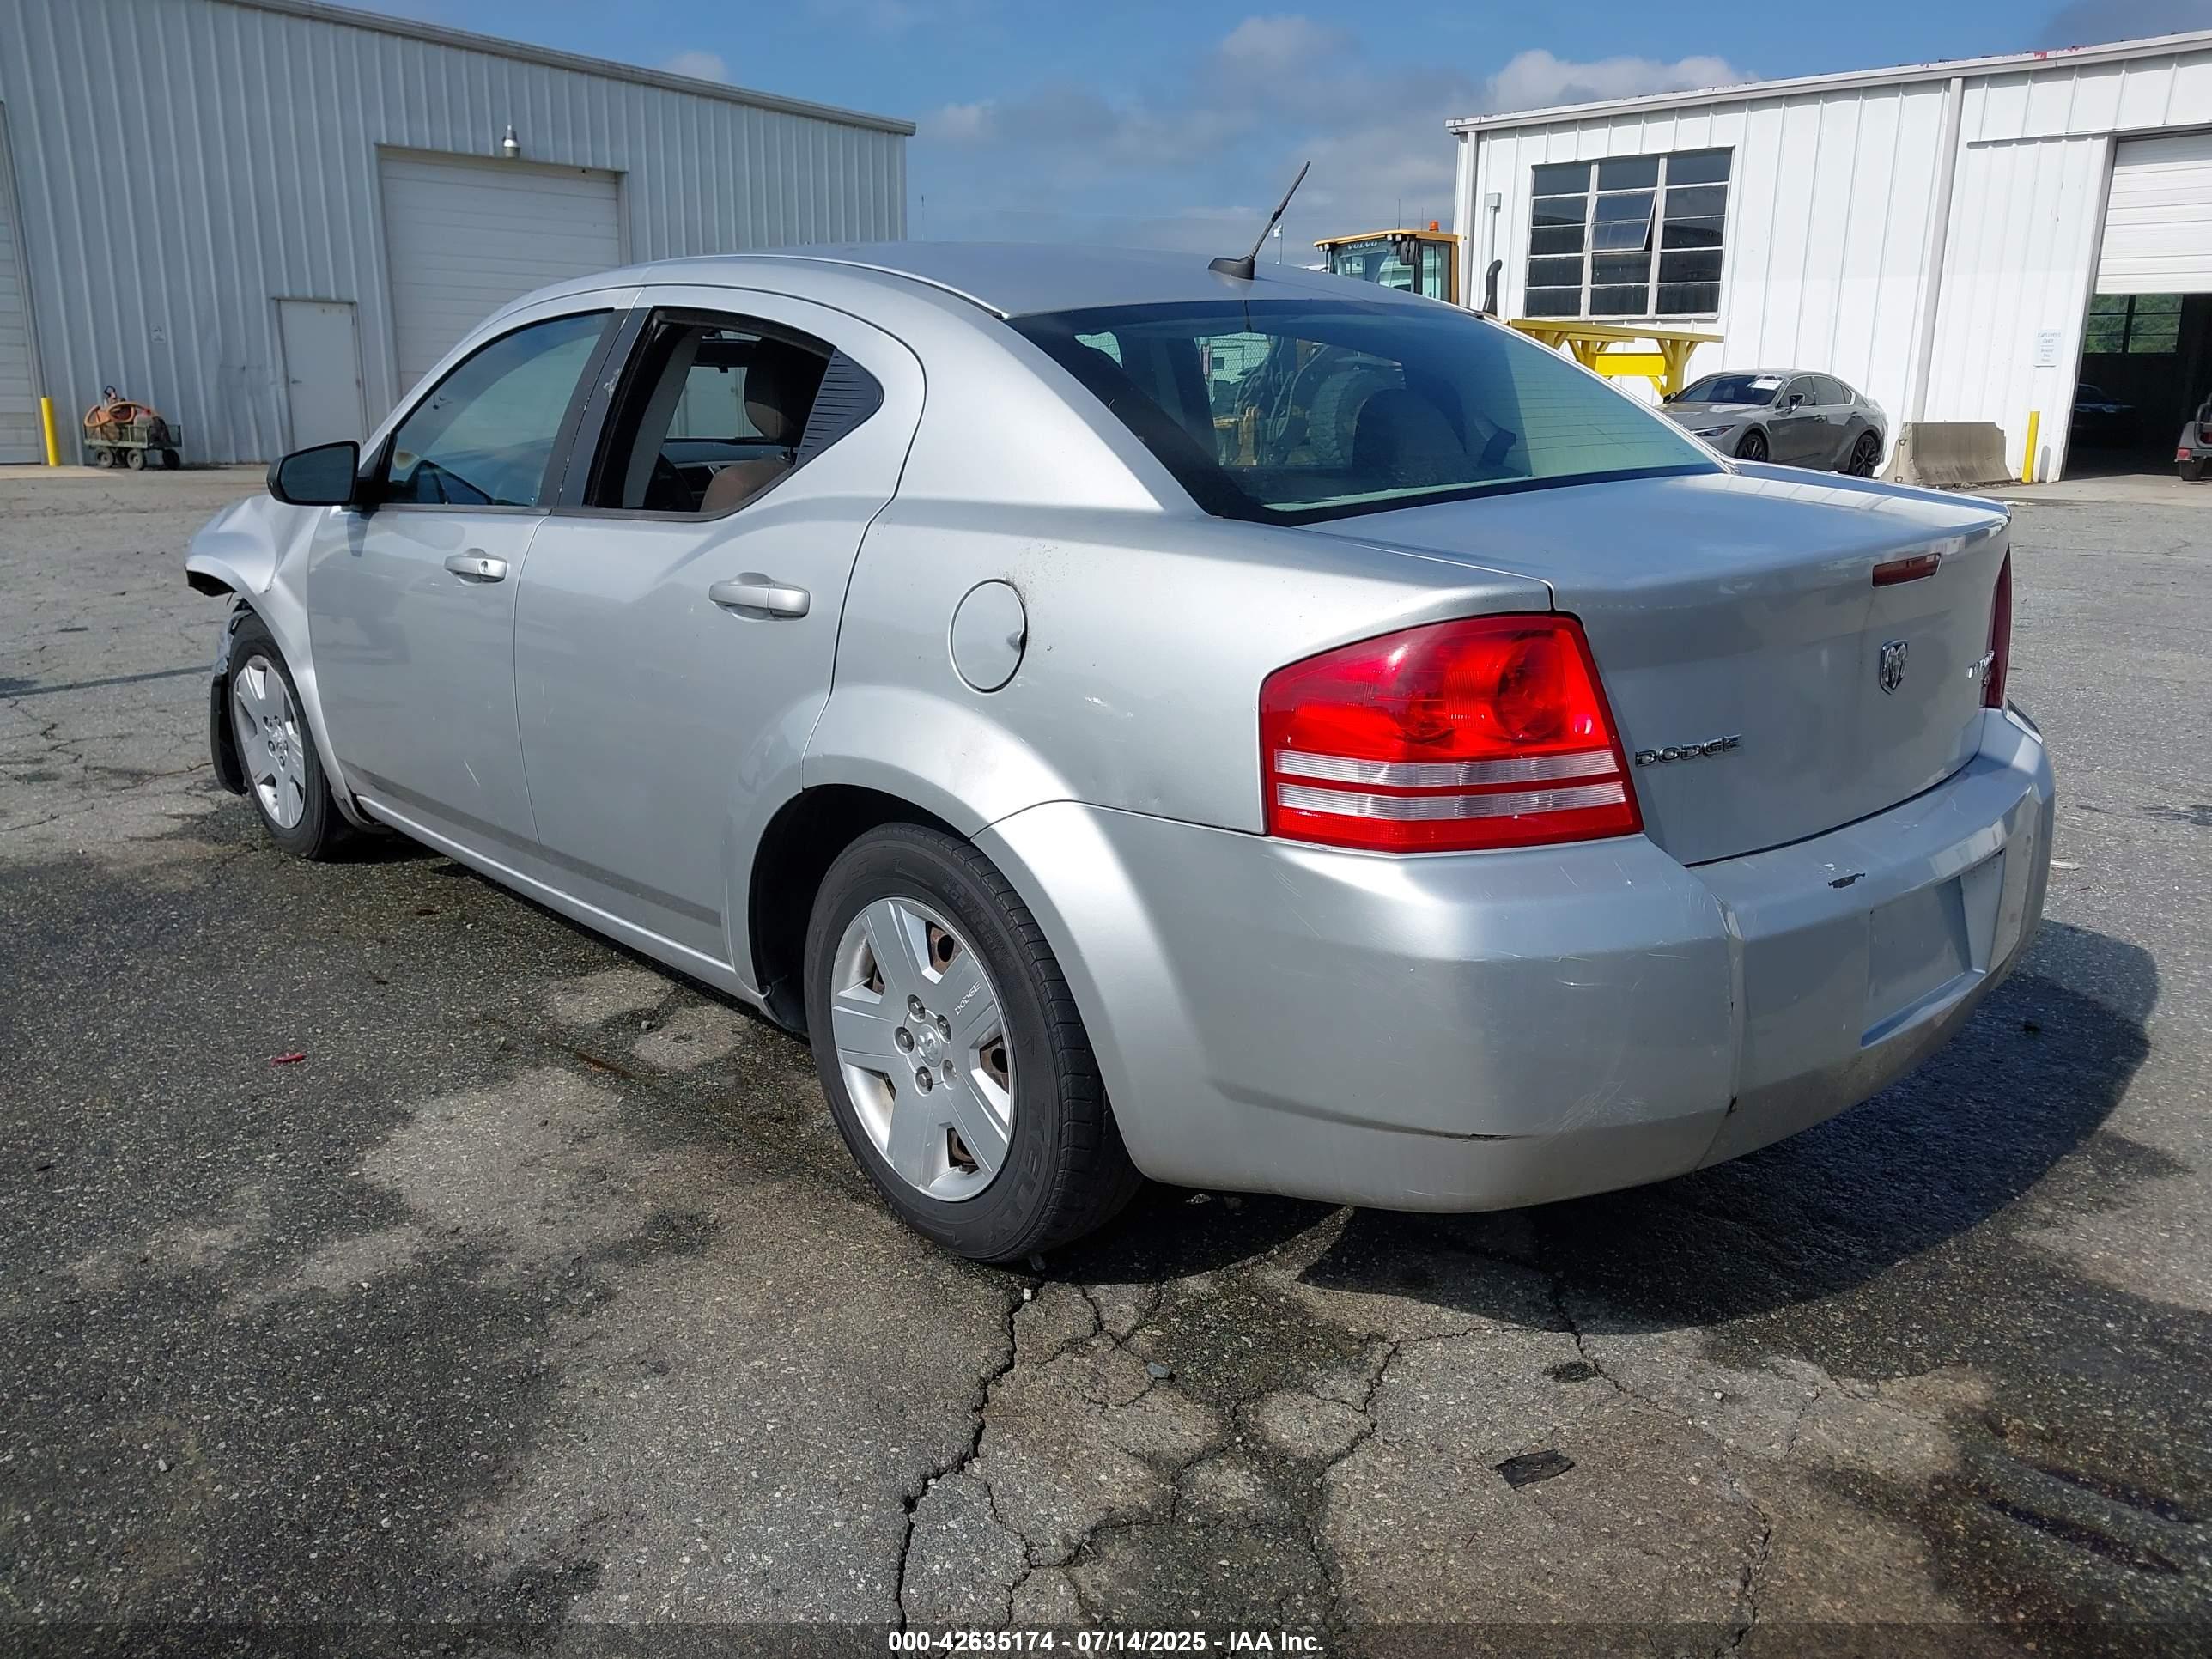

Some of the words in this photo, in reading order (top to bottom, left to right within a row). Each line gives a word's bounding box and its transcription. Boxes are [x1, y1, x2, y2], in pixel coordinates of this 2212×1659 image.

[1347, 241, 1378, 250] VOLVO
[1635, 733, 1742, 767] DODGE
[954, 981, 981, 1016] DODGE
